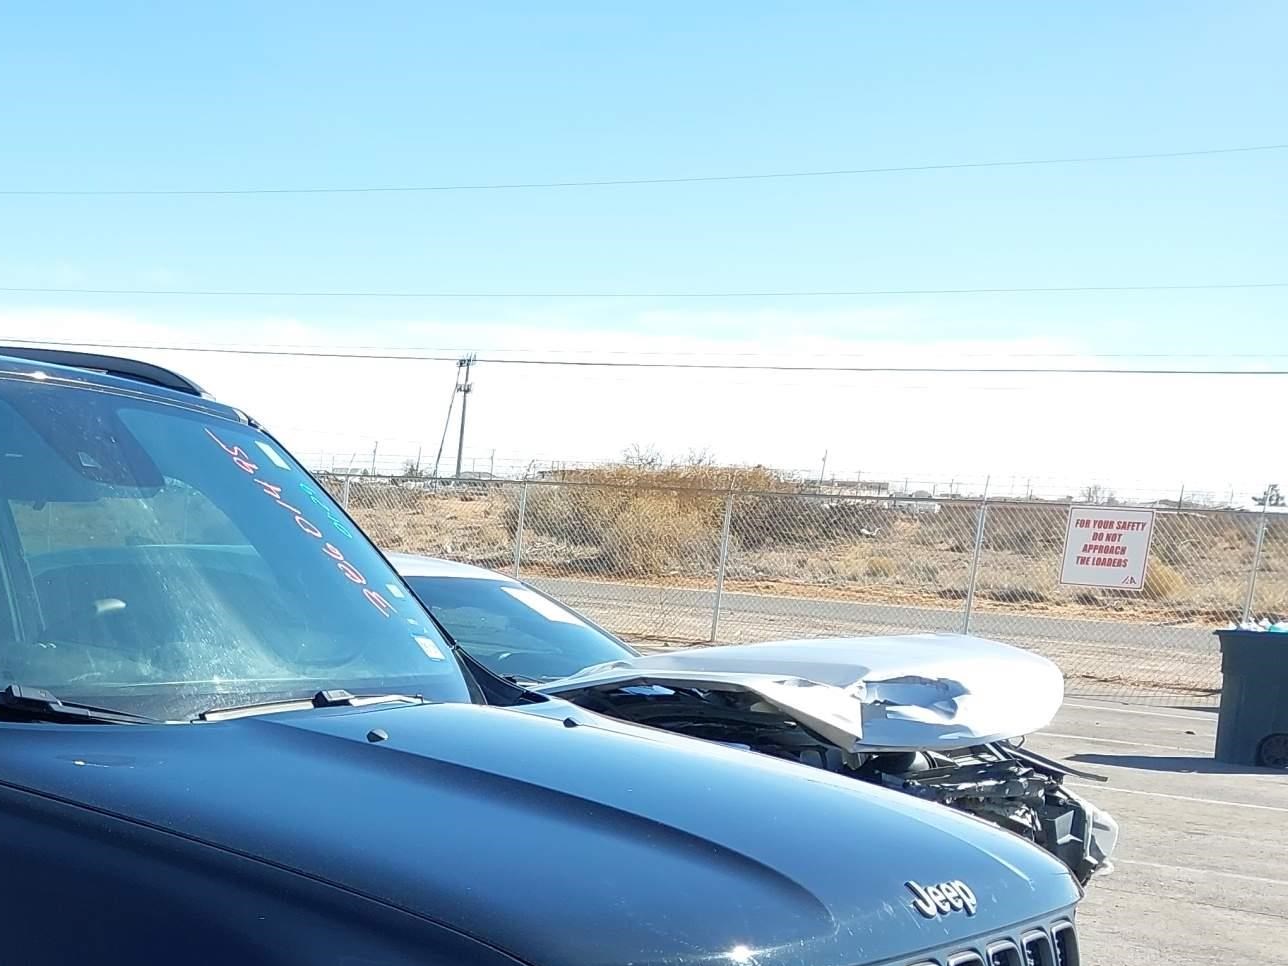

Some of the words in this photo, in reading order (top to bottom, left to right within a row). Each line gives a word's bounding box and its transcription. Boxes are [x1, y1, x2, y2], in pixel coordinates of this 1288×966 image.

[1075, 518, 1091, 528] FOR
[1092, 519, 1114, 529] YOUR
[1115, 521, 1146, 531] SAFETY
[1092, 531, 1104, 542] DO
[1105, 533, 1123, 543] NOT
[1082, 544, 1127, 555] APPROACH
[1076, 556, 1091, 566] THE
[1092, 556, 1129, 568] LOADERS
[904, 880, 977, 919] Jeep
